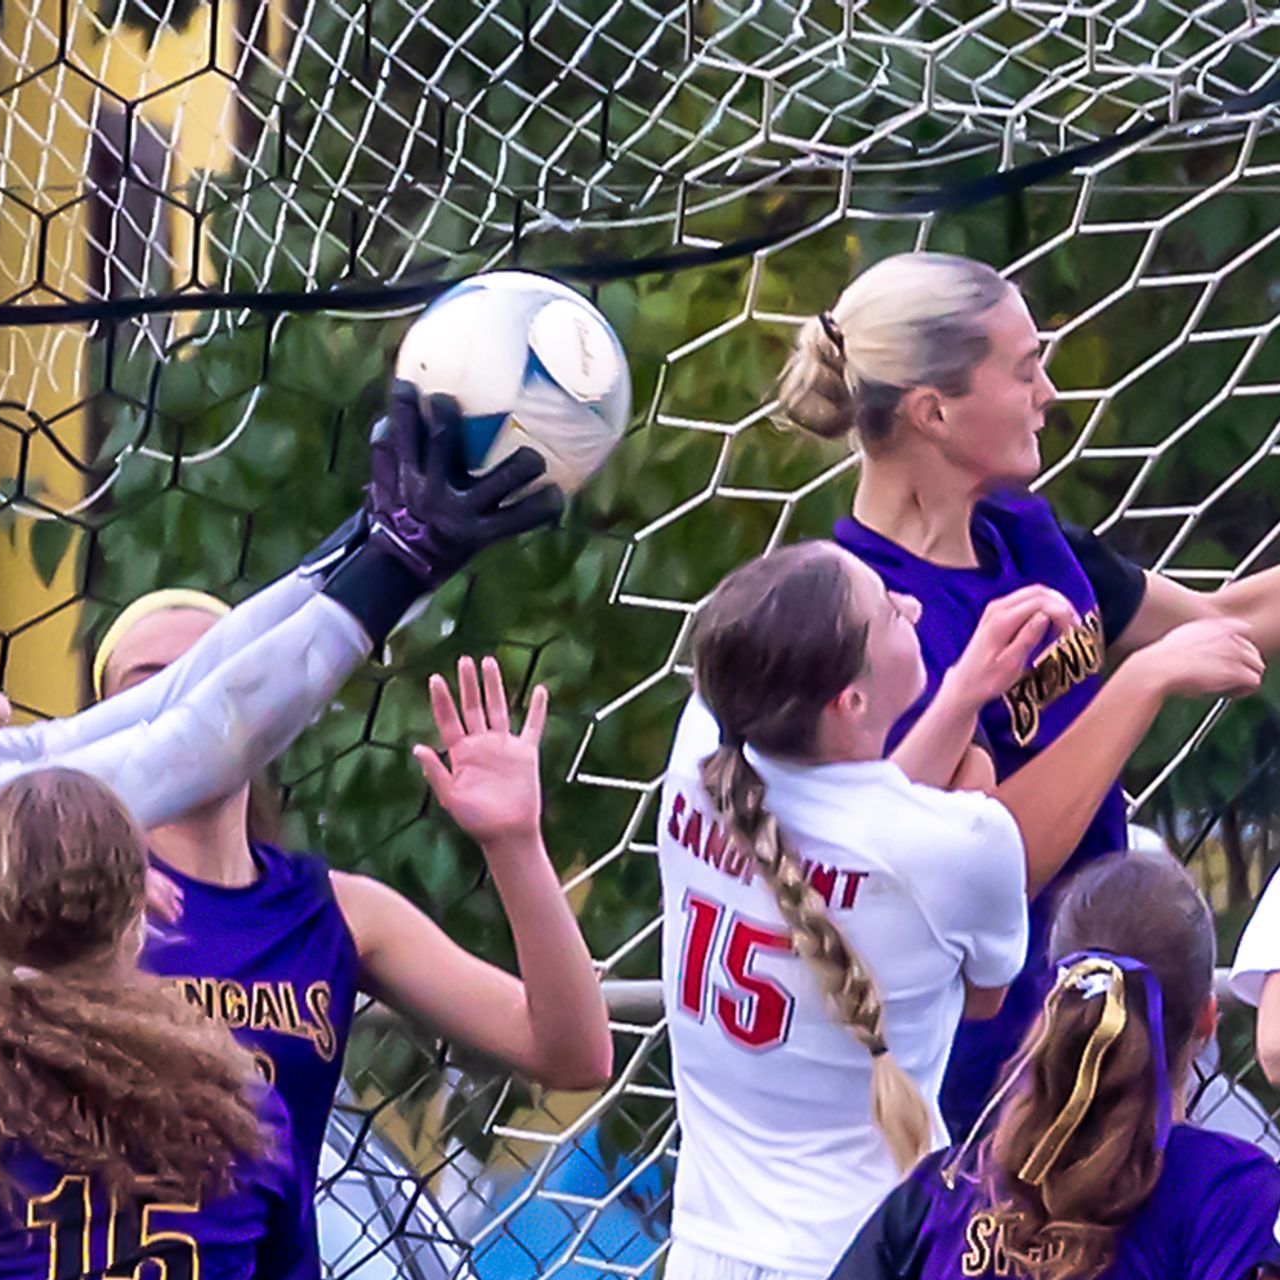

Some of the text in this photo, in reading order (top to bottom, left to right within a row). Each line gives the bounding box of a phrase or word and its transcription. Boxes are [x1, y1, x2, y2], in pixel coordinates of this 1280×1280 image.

[667, 792, 869, 909] SANDINT
[176, 977, 336, 1063] NGALS
[678, 887, 795, 1056] 15
